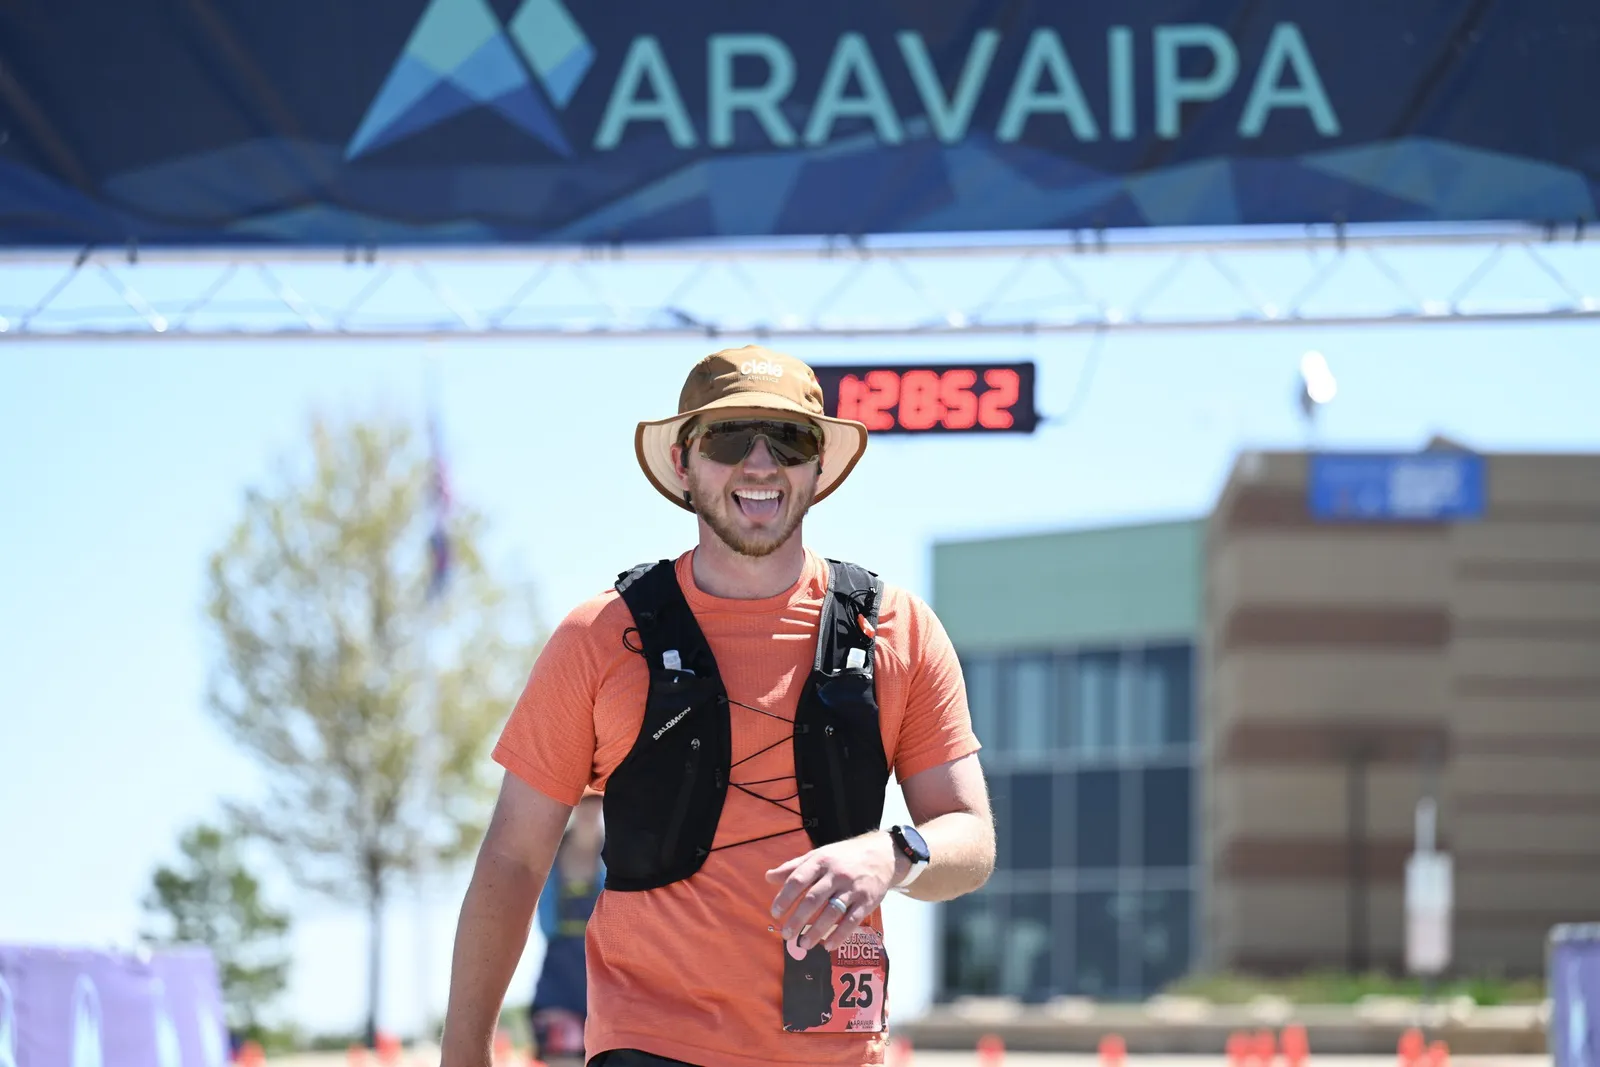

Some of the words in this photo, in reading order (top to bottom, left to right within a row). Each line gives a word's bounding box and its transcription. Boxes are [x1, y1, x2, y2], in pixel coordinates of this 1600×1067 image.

[595, 23, 1340, 149] ARAVAIPA
[652, 706, 691, 740] SALOMON
[838, 944, 880, 959] RIDGE
[839, 973, 873, 1008] 25
